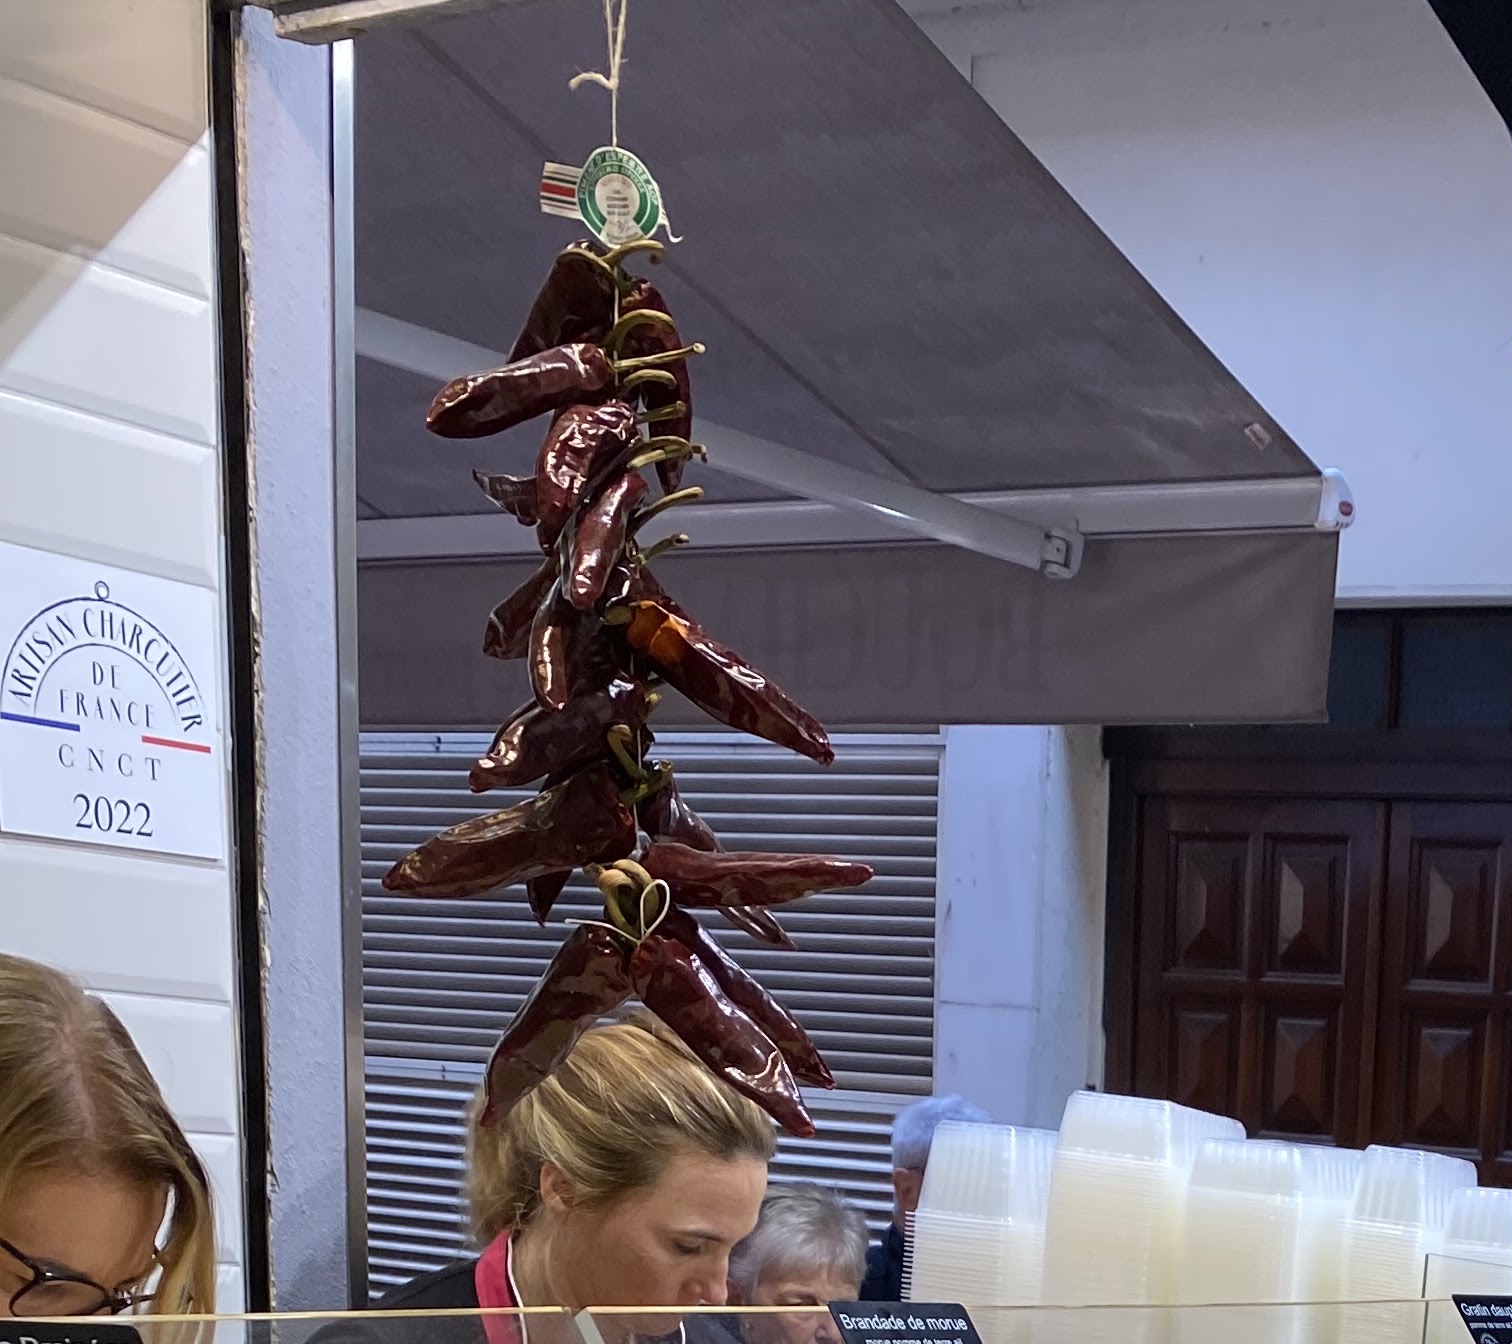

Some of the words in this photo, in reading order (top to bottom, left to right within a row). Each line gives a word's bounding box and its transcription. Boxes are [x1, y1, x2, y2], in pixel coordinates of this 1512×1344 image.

[8, 613, 77, 706] ARTISAN
[82, 606, 204, 733] CHARCUTIER
[91, 660, 121, 690] DE
[59, 688, 155, 729] FRANCE
[73, 793, 154, 838] 2022
[839, 1312, 907, 1331] Brandade
[907, 1314, 926, 1331] de
[926, 1316, 968, 1332] morue
[1460, 1302, 1492, 1318] Gratin
